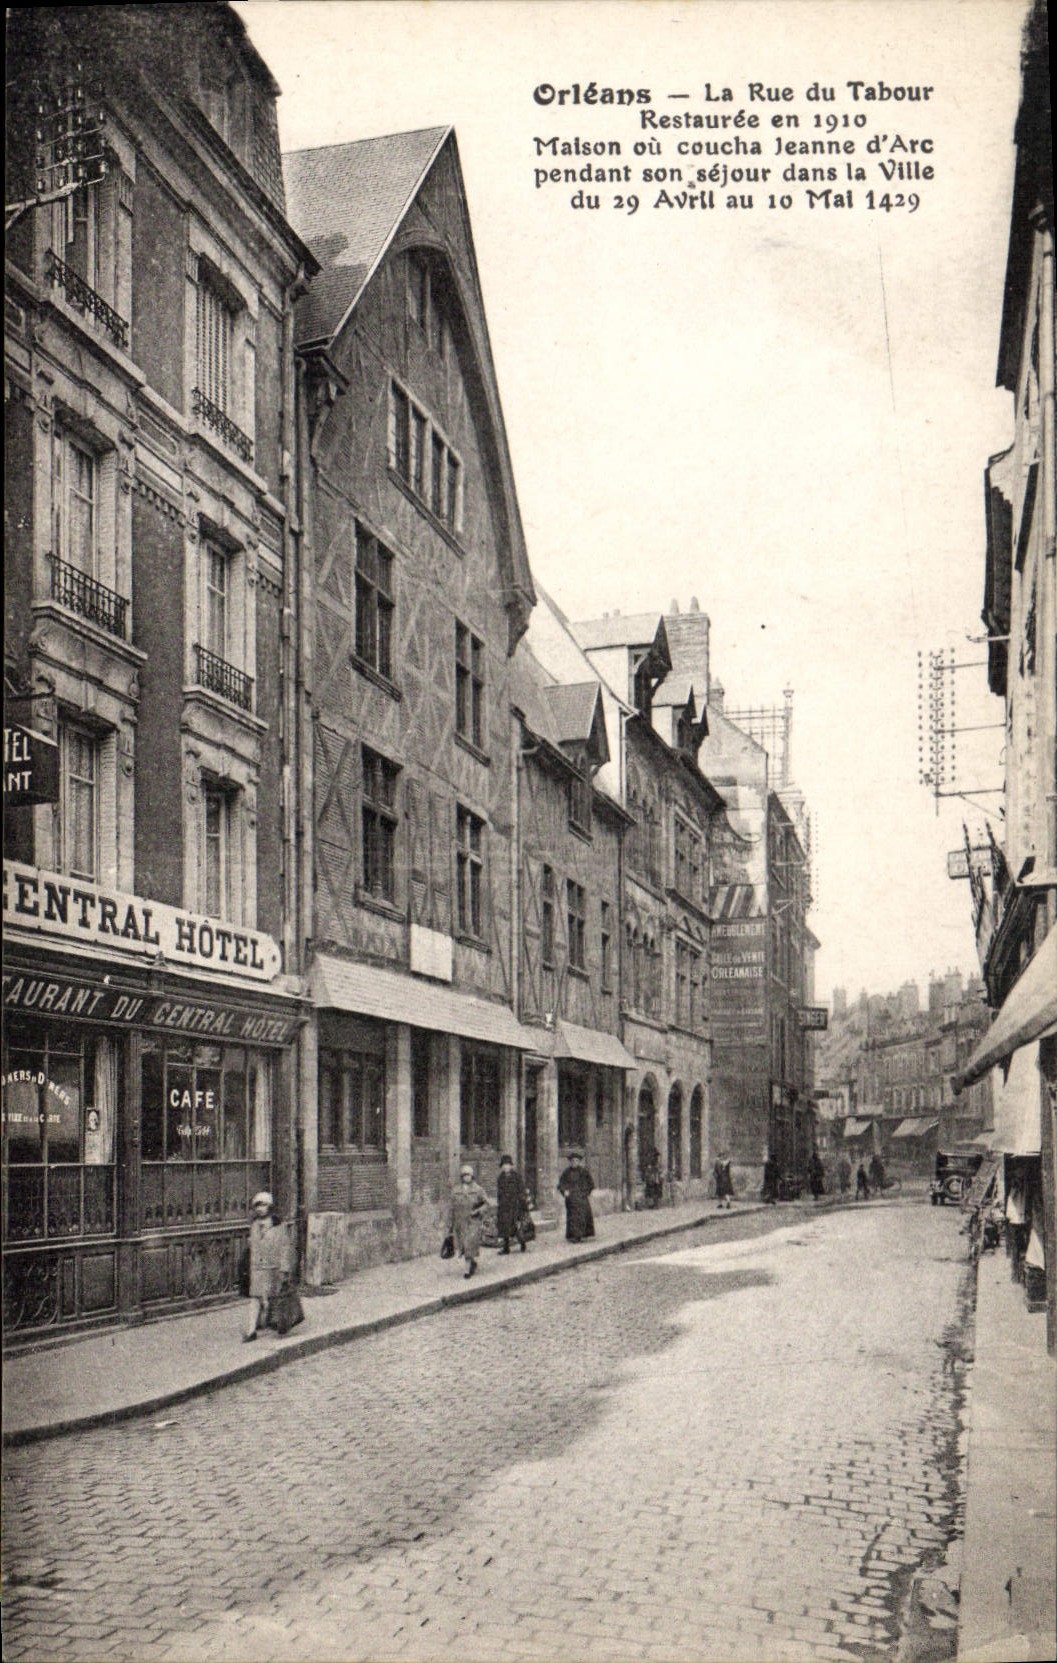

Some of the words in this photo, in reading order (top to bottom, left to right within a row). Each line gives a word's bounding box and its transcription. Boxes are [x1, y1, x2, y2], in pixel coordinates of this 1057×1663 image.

[4, 771, 32, 792] NT
[3, 869, 160, 945] ENTRAL
[175, 917, 264, 970] HÔTEL
[110, 995, 144, 1020] DU
[153, 1002, 234, 1034] CENTRAL
[38, 1071, 71, 1106] DNERS
